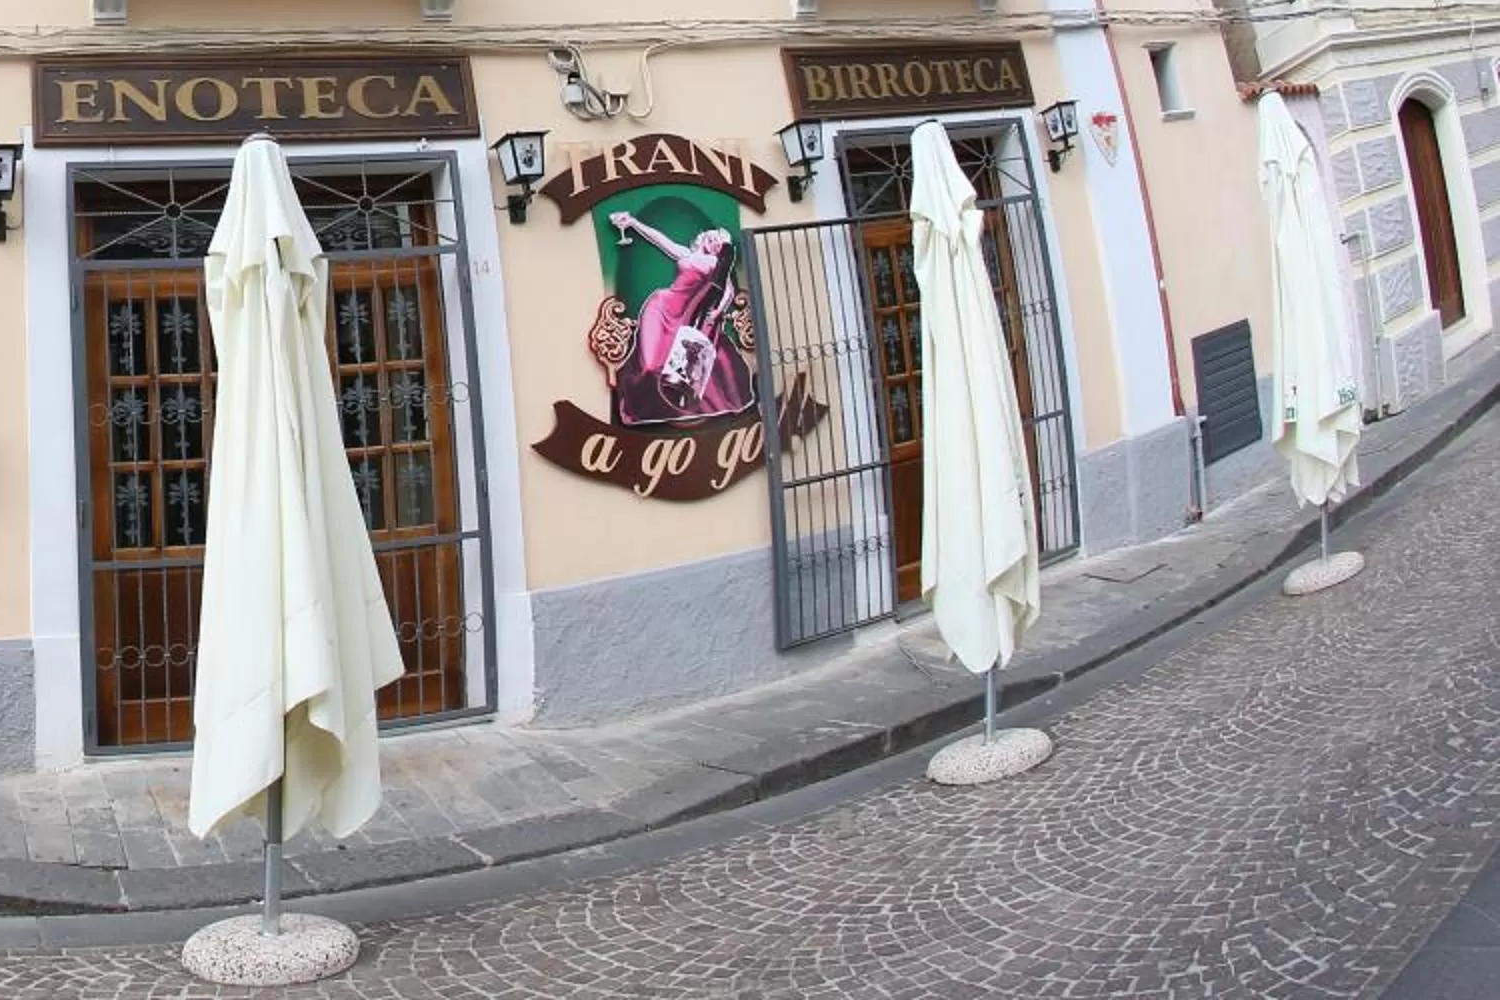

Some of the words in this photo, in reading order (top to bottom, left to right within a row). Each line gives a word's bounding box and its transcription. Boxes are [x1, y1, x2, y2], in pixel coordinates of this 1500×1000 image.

[54, 75, 460, 123] ENOTECA
[802, 58, 1022, 101] BIRROTECA
[554, 138, 762, 198] TRANI
[581, 433, 623, 474] a
[633, 435, 695, 498] go
